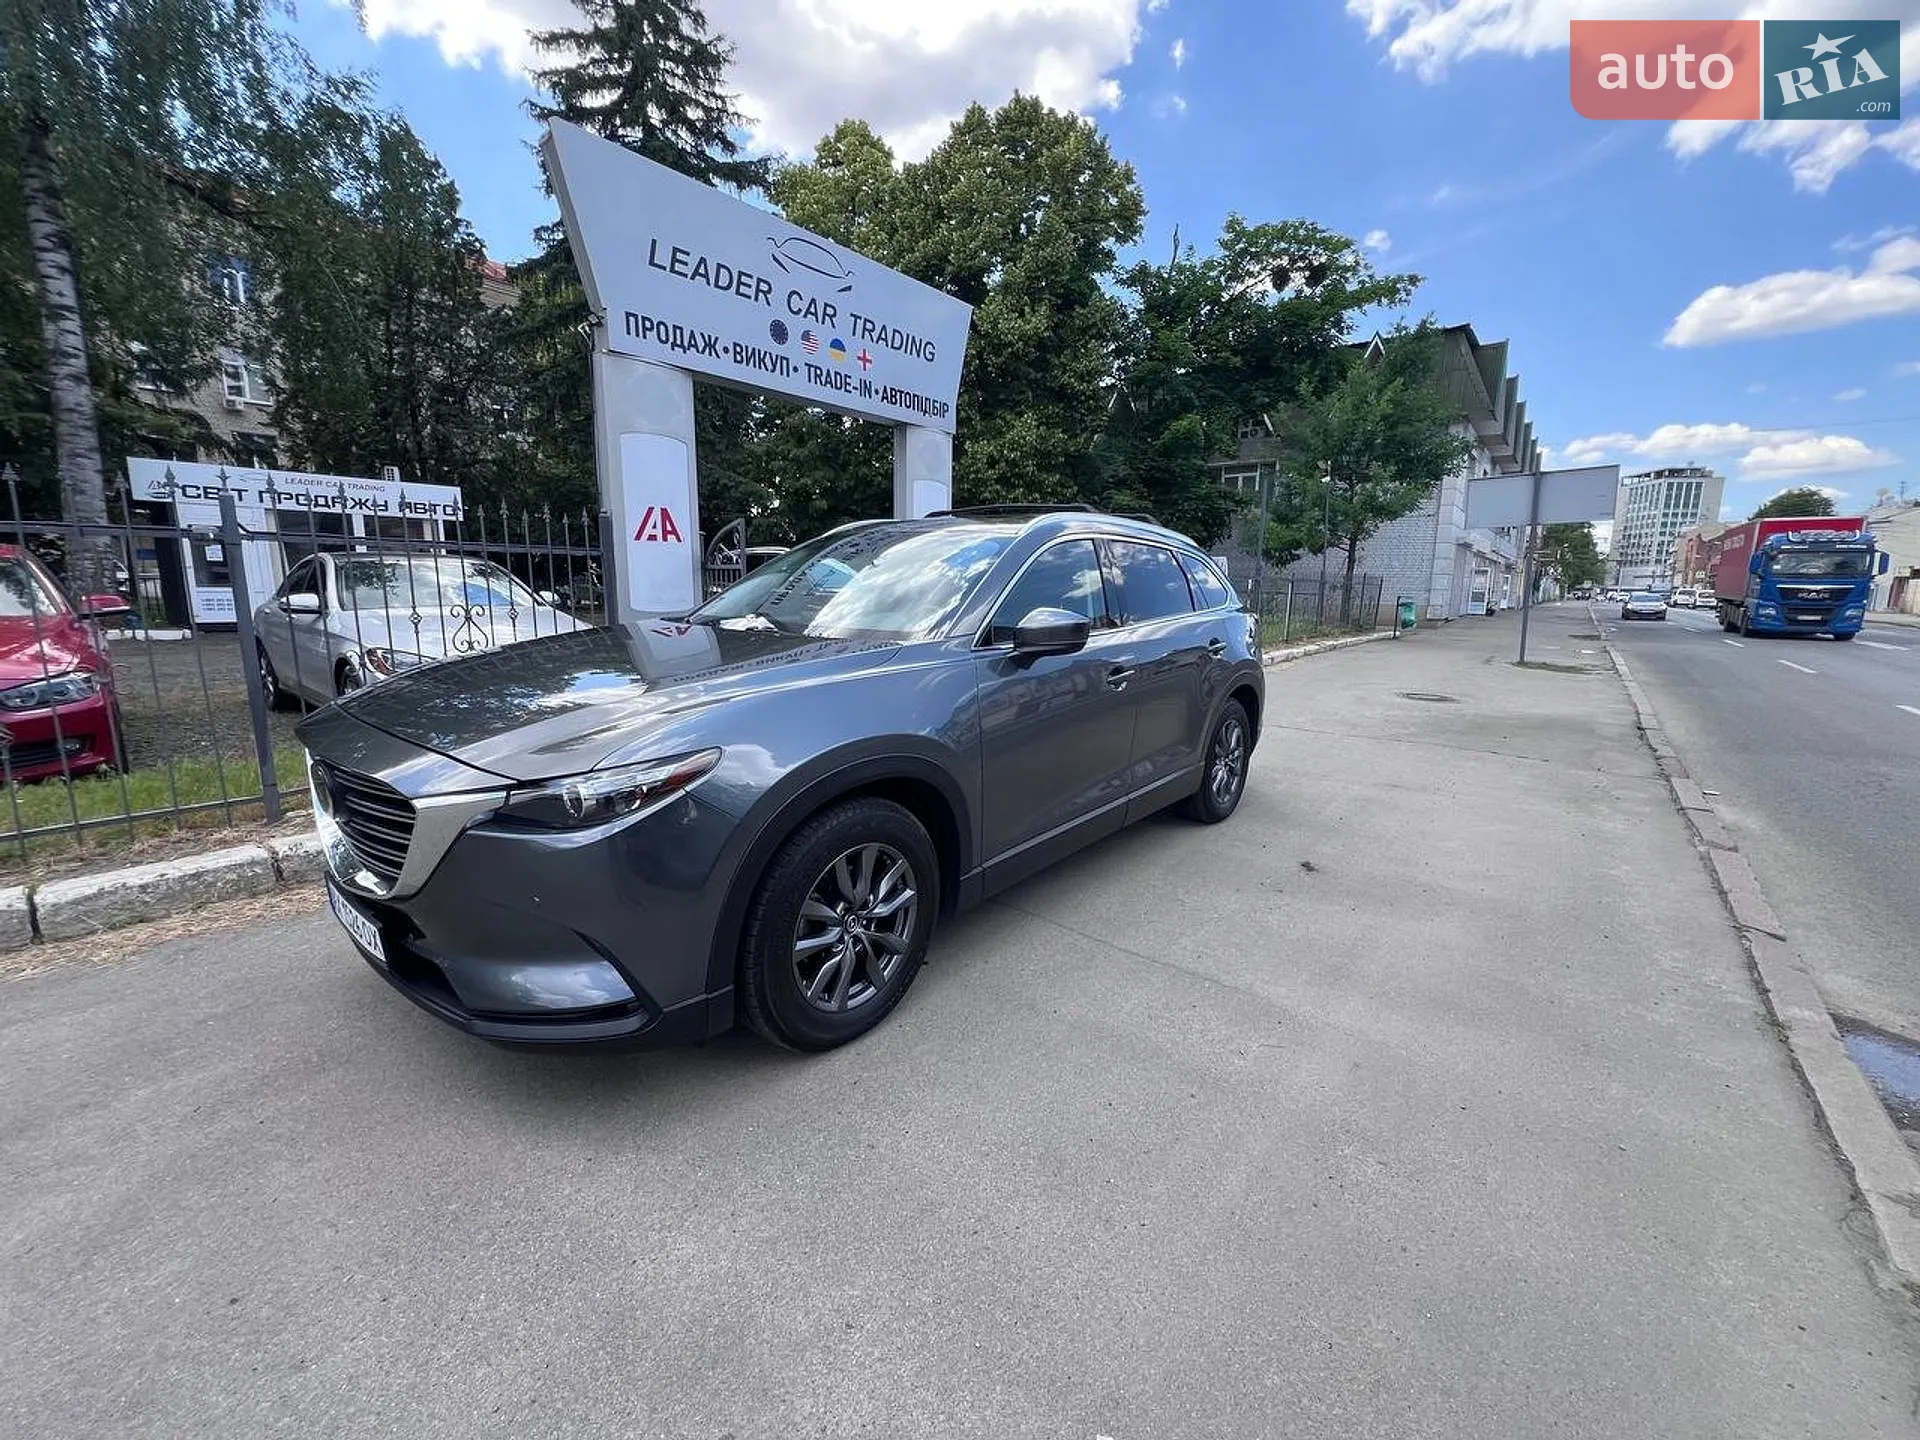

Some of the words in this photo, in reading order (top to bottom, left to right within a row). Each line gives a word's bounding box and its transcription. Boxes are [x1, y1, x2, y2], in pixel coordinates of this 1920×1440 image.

[648, 238, 773, 307] LEADER
[786, 289, 837, 329] CAR
[849, 312, 937, 362] TRADING
[624, 311, 720, 359] ПРОДАЖ
[732, 341, 791, 378] ВИКУП
[804, 362, 873, 399] TRADE-IN
[881, 385, 949, 418] АВТОПІДБІР
[181, 484, 248, 502] СВТ
[284, 477, 324, 487] LEADER
[347, 483, 385, 492] TRADING
